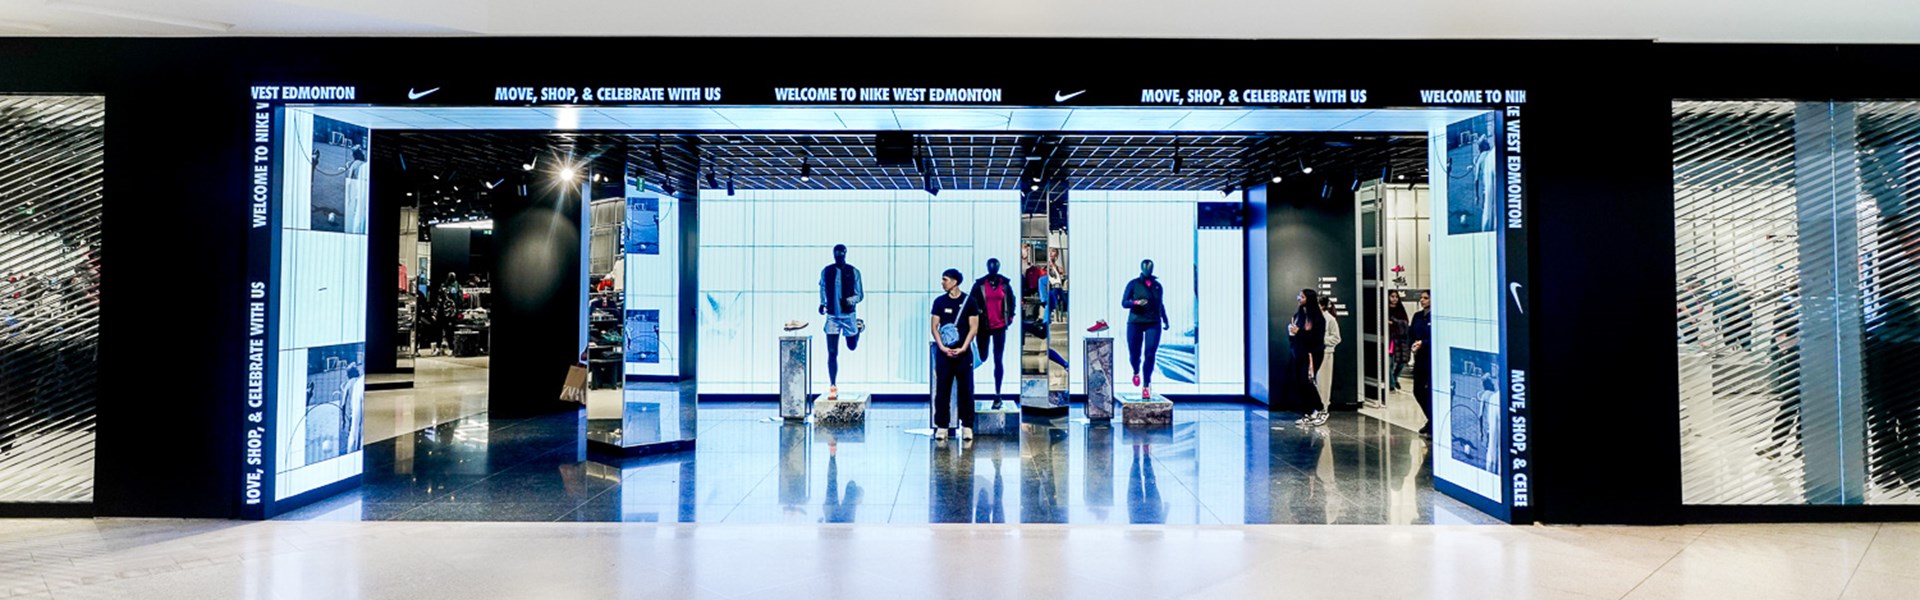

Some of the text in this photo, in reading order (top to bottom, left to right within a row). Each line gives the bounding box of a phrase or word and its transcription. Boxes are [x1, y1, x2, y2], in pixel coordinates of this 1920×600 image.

[281, 86, 356, 100] EDMONTON
[494, 87, 722, 104] MOVE, SHOP, & CELEBRATE WITH US
[774, 88, 1002, 102] WELCOME TO NIKE WEST EDMONTON
[1140, 89, 1367, 105] MOVE, SHOP, & CELEBRATE WITH US
[1419, 90, 1483, 103] WELCOME
[1484, 90, 1502, 103] TO
[255, 112, 270, 143] NIKE
[1506, 119, 1521, 154] WEST
[254, 145, 269, 163] TO
[253, 165, 269, 228] WELCOME
[1508, 155, 1523, 229] EDMONTON
[250, 281, 266, 299] US
[249, 302, 265, 337] WITH
[248, 339, 264, 408] CELEBRATE
[1509, 369, 1527, 413] MOVE,
[248, 411, 263, 423] &
[247, 426, 265, 465] SHOP,
[1510, 416, 1527, 455] SHOP,
[1512, 457, 1527, 470] &
